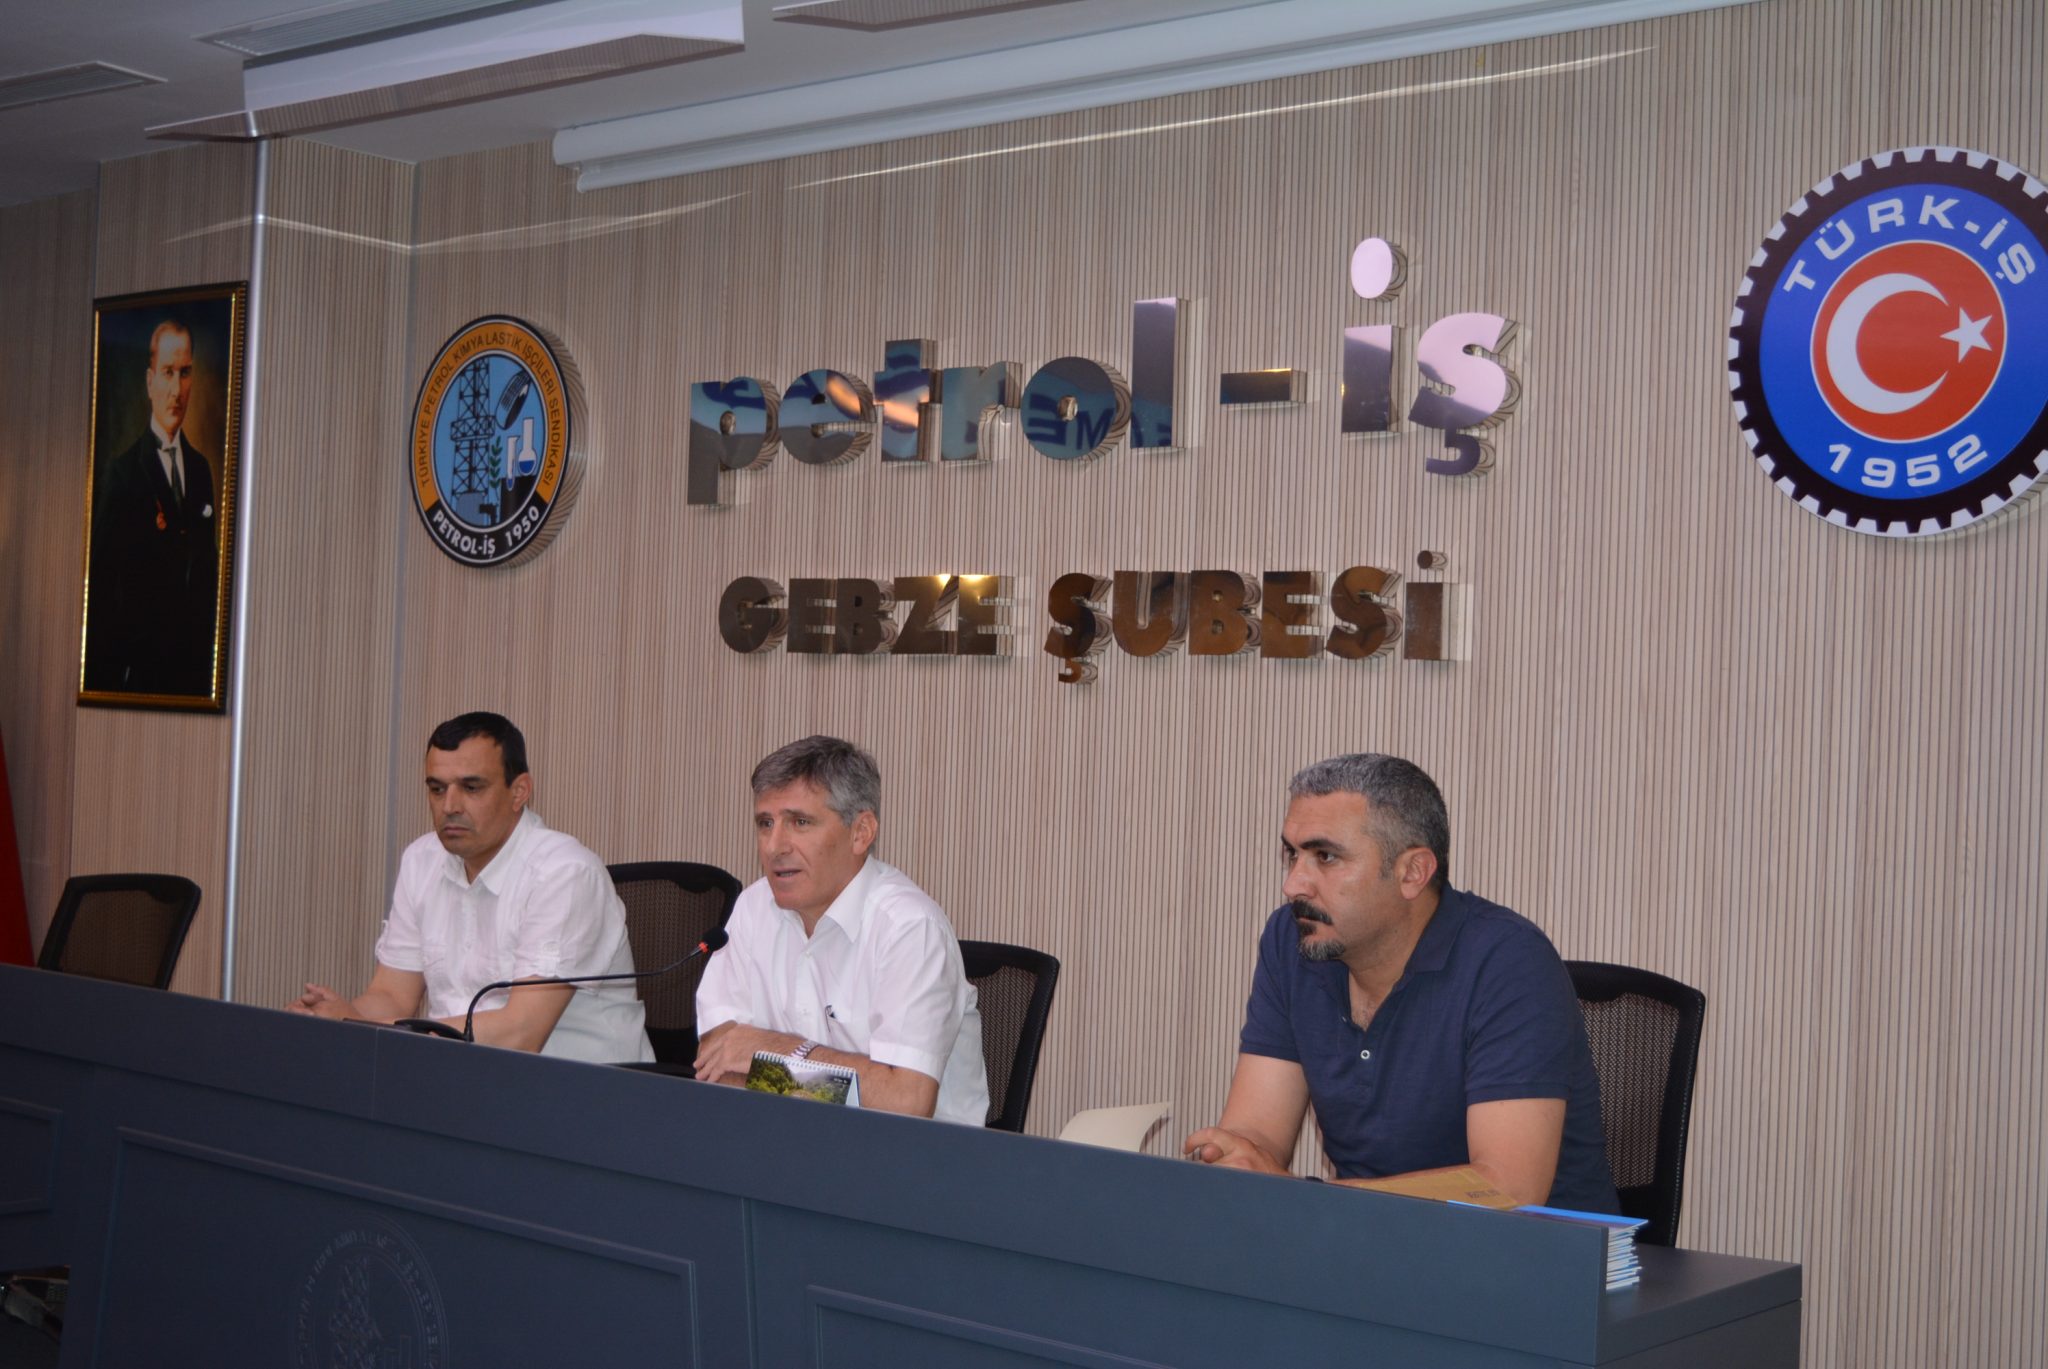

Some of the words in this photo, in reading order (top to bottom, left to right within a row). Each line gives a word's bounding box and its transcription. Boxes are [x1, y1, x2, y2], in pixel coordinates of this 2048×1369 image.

[1782, 194, 2036, 293] TÜRK-İŞ
[424, 362, 454, 416] PETROL
[1828, 433, 1989, 488] 1952
[433, 509, 496, 560] PETROL-İŞ
[505, 505, 540, 548] 1950
[718, 573, 1002, 657] GEBZE
[1043, 550, 1446, 684] ŞUBESİ
